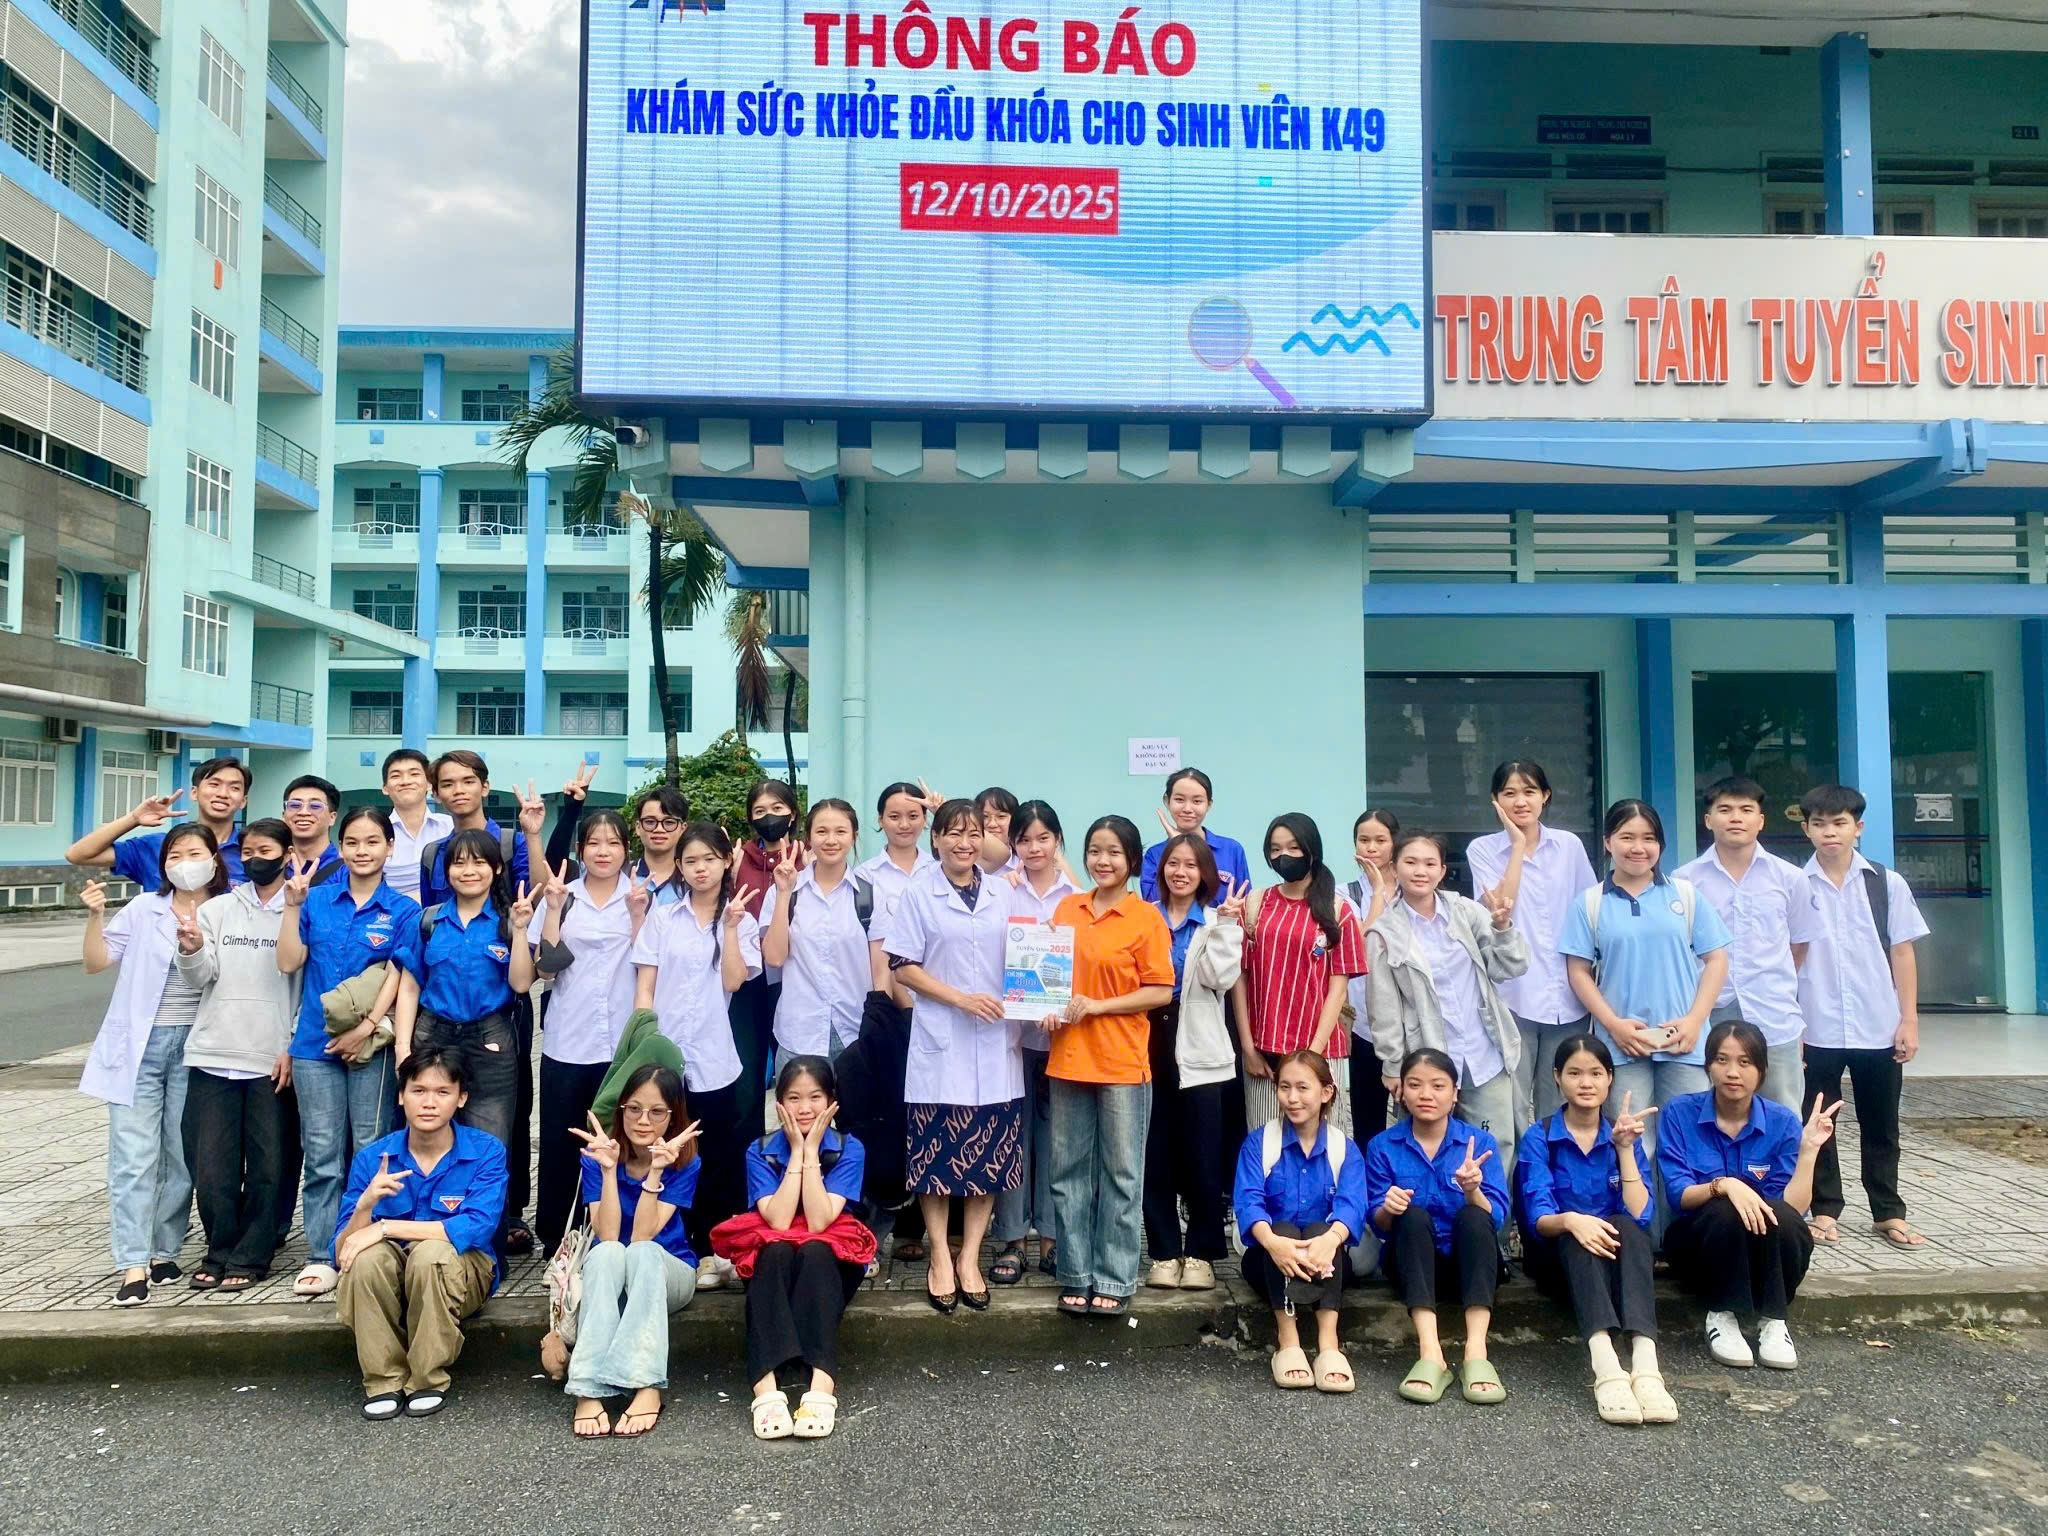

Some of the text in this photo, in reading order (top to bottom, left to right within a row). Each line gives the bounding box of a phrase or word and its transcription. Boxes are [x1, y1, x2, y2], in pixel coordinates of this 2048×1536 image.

[803, 0, 1197, 76] THÔNG BÁO
[626, 78, 1386, 153] KHÁM SỨC KHỎE ĐẦU KHÓA CHO SINH VIÊN K49
[907, 180, 1116, 220] 12/10/2025
[1436, 250, 2048, 386] TRUNG TÂM TUYỂN SINH
[222, 934, 259, 950] Climbng
[1049, 944, 1071, 954] 2025
[1006, 987, 1025, 1003] 27
